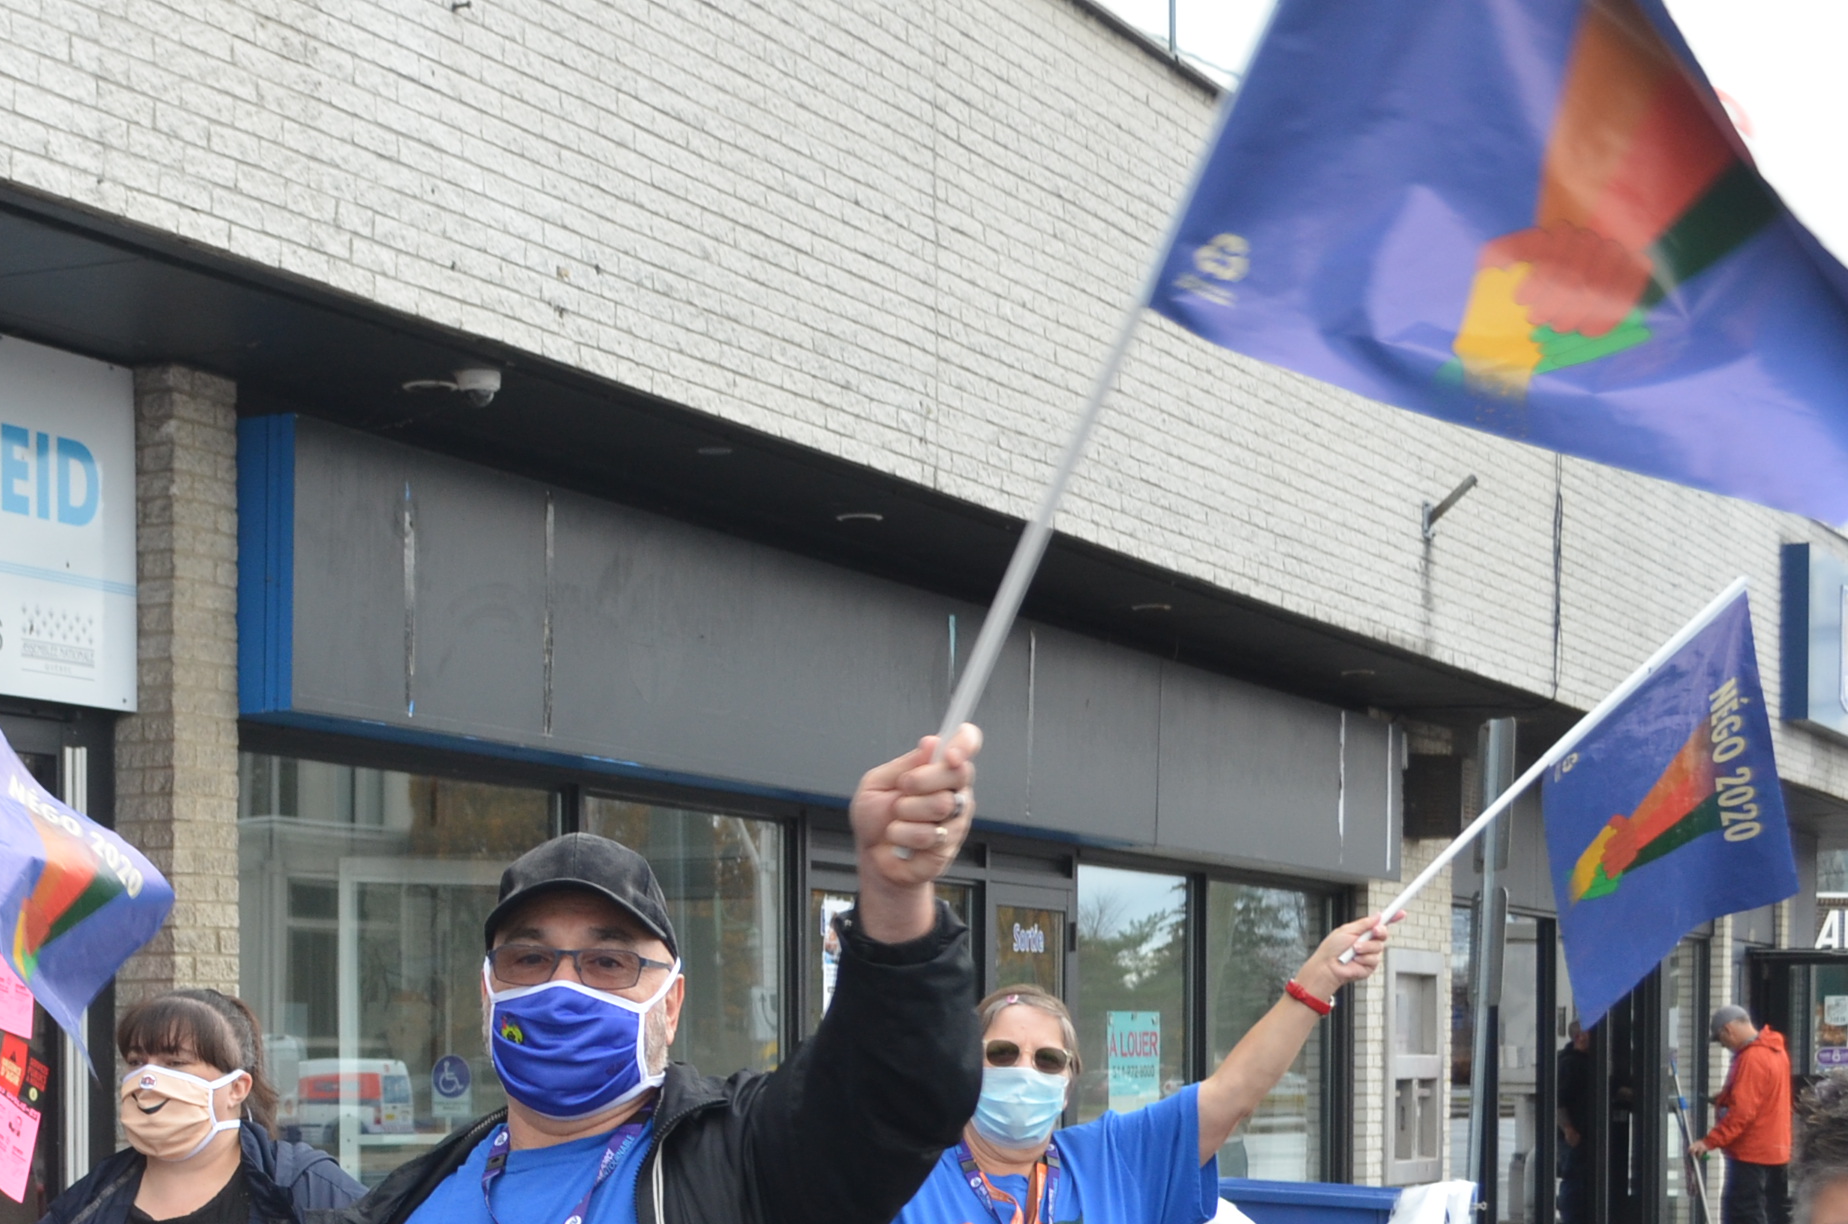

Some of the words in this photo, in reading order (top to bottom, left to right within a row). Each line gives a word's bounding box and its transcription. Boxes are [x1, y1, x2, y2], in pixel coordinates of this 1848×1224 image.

[1709, 676, 1750, 765] NÉGO
[8, 774, 84, 838] NÉGO
[89, 831, 144, 900] 2020
[1714, 766, 1763, 843] 2020
[1013, 922, 1045, 953] Sortie
[1120, 1031, 1159, 1057] LOUER
